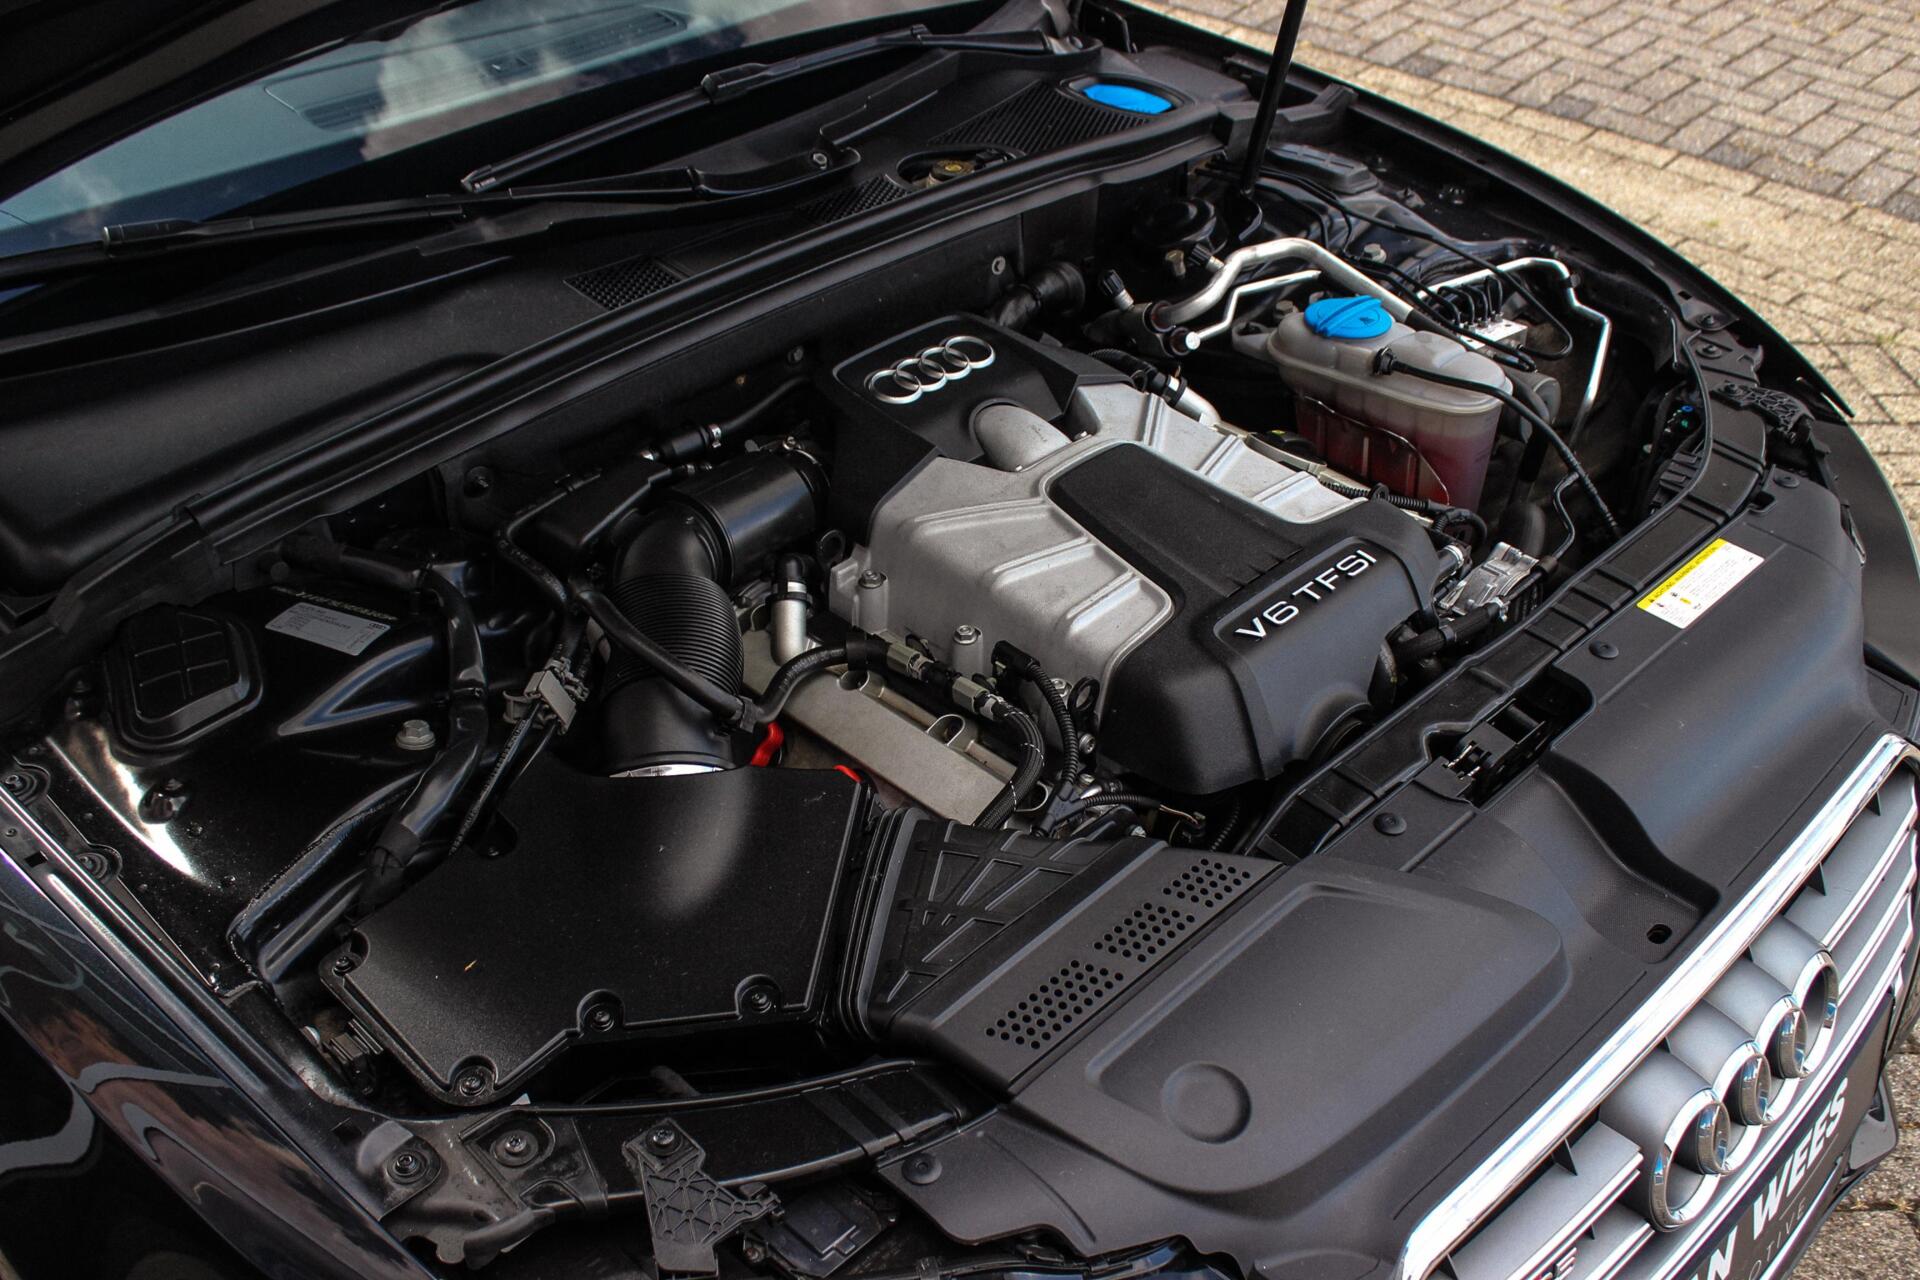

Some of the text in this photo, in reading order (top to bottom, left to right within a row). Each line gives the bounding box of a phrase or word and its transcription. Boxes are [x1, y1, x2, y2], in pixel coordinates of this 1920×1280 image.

[1234, 549, 1377, 639] V6 TFSI
[1753, 1077, 1848, 1240] WEES
